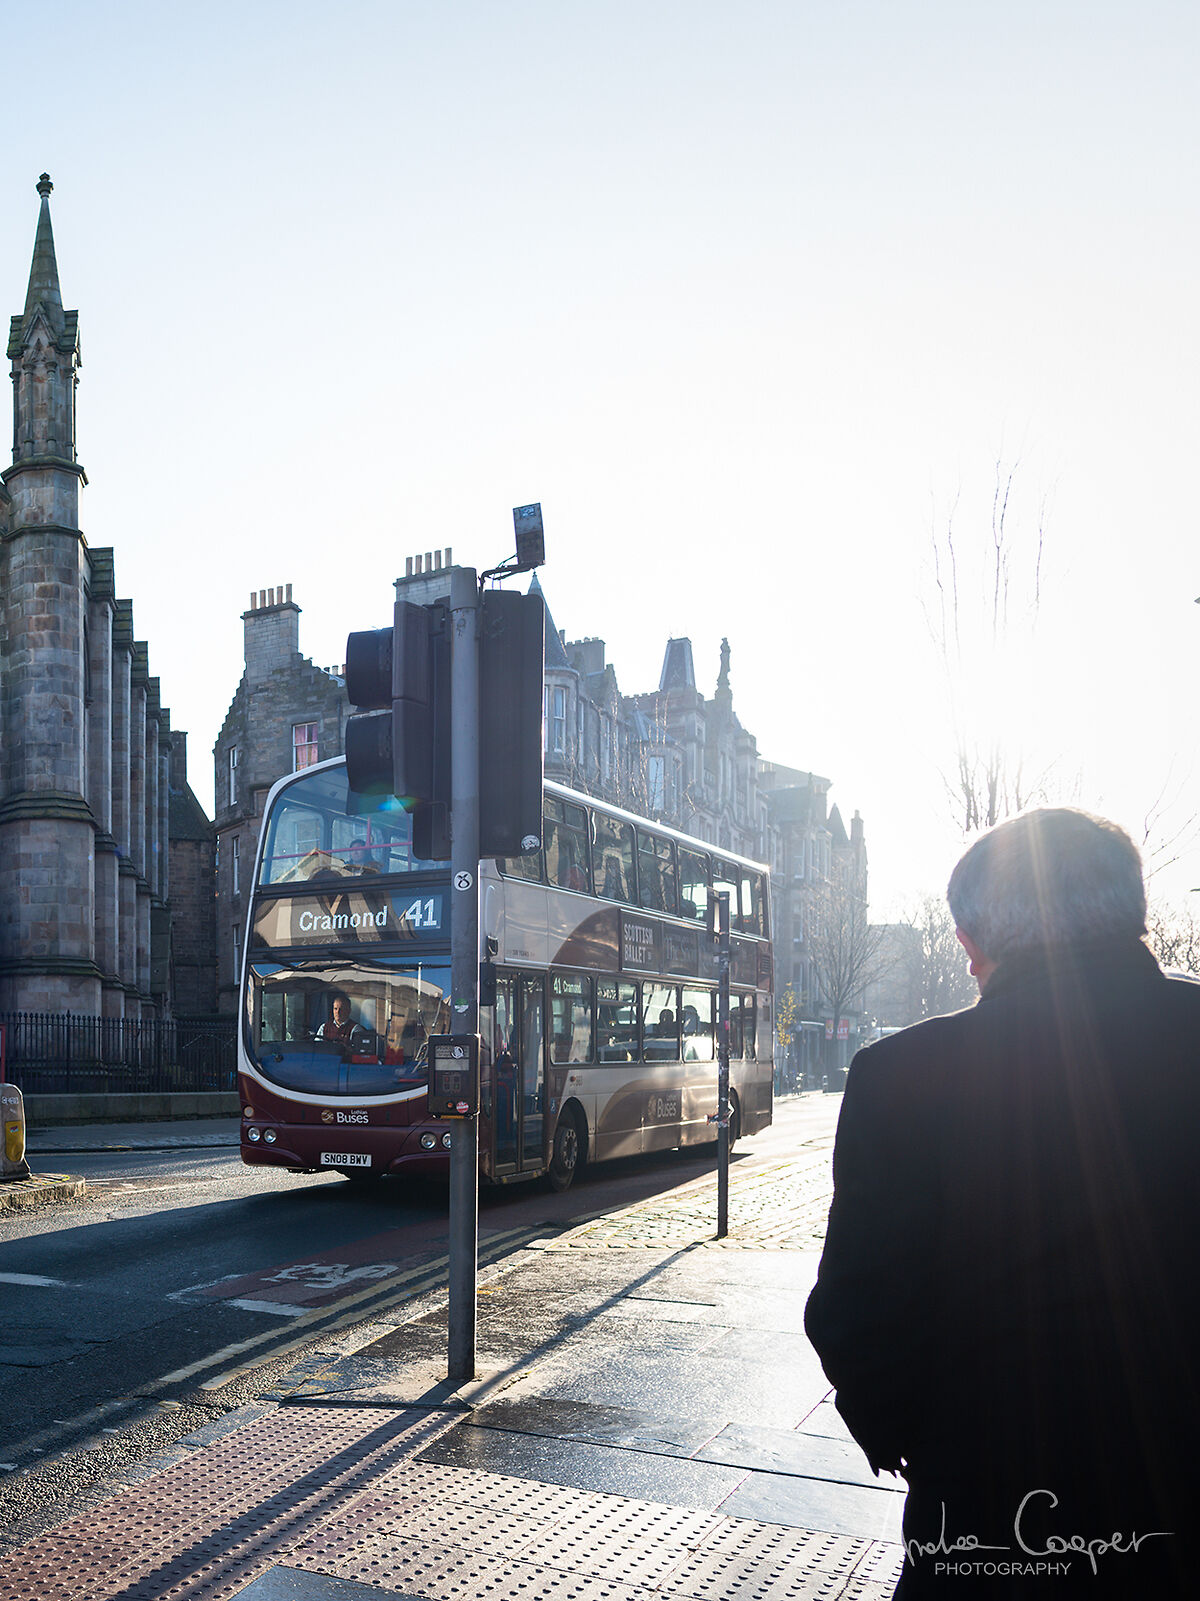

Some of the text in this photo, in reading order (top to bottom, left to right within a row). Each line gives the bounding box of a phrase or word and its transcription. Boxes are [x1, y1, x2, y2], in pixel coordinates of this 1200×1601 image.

[299, 898, 437, 931] Cramond 41
[624, 923, 654, 945] SCOTTISH
[624, 944, 646, 963] BALLET
[553, 977, 562, 994] 41
[657, 1098, 677, 1118] Buses
[336, 1112, 369, 1124] Buses
[324, 1153, 368, 1165] SN08 BWV
